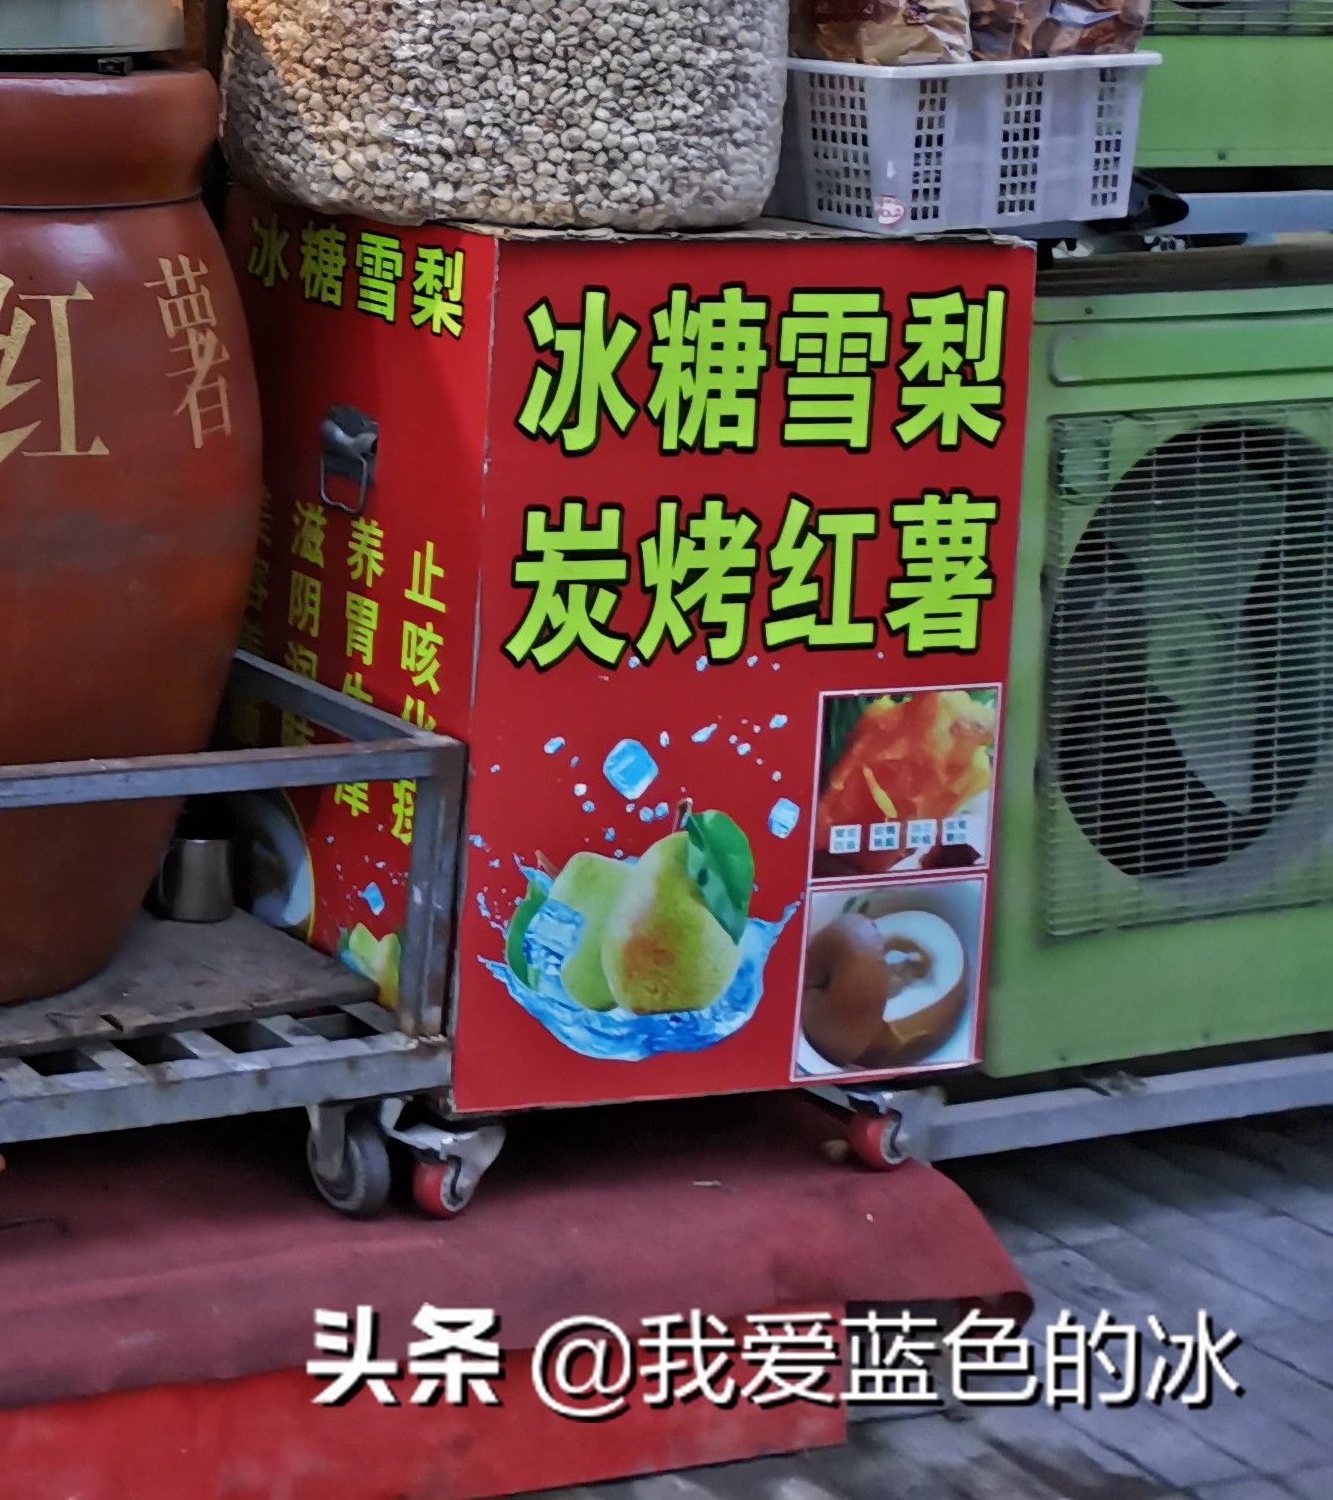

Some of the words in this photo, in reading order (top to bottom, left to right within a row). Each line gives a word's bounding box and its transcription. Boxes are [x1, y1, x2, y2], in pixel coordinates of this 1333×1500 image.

[247, 211, 465, 339] 冰糖雪梨
[515, 285, 1008, 456] 冰糖雪梨
[501, 490, 1001, 669] 炭烤红薯
